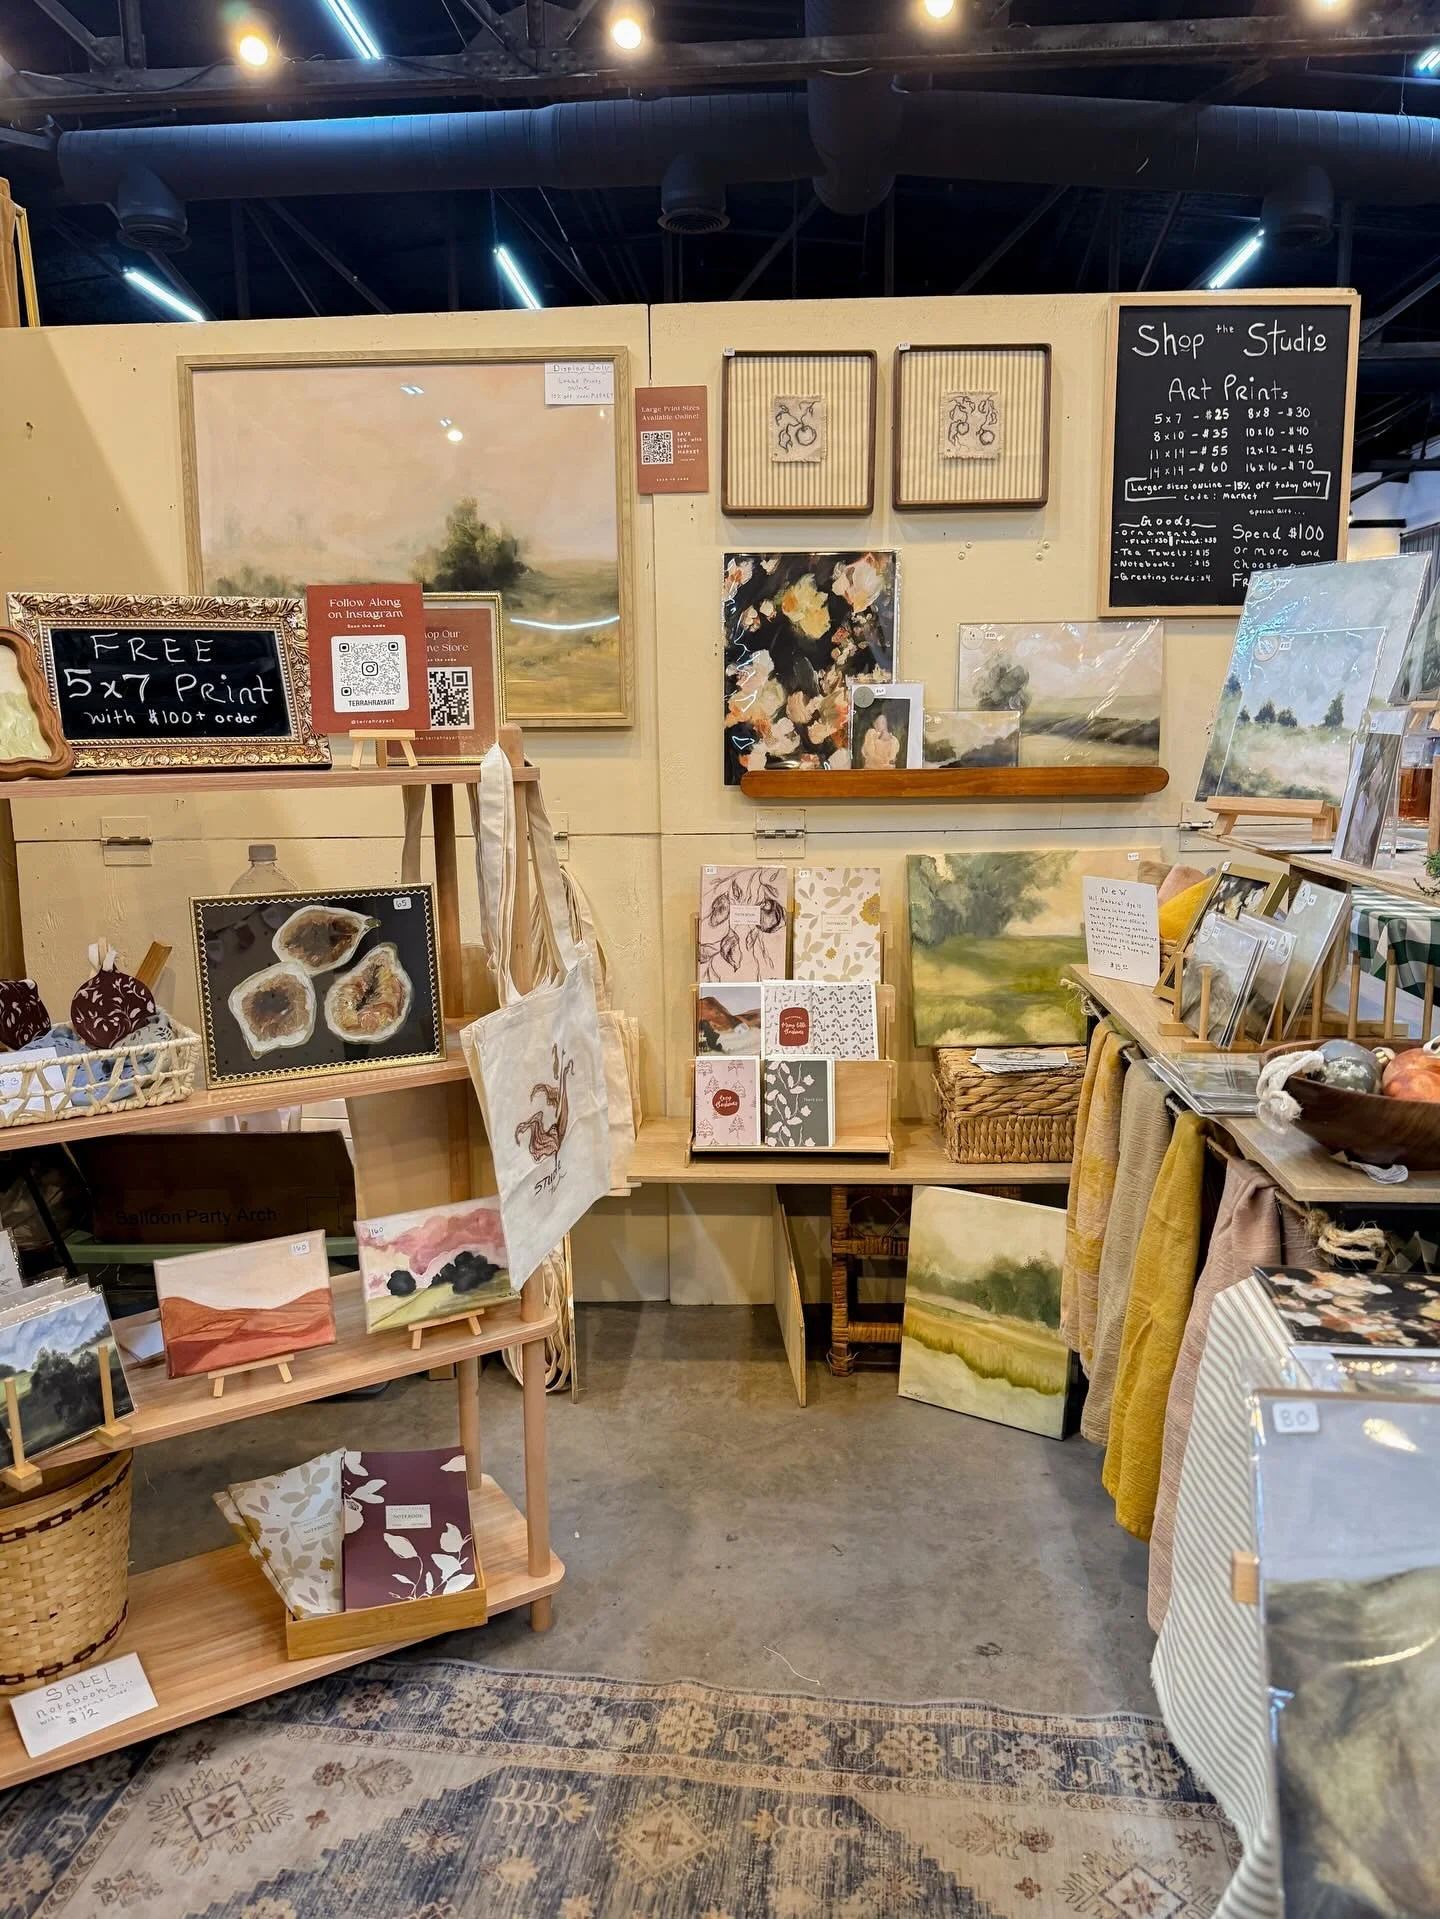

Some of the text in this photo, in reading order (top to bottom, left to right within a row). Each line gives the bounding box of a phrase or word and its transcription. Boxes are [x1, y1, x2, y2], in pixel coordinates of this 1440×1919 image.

[1132, 320, 1327, 359] Shop the Studio
[1168, 374, 1288, 402] Art Prints
[1131, 483, 1162, 495] Larger
[1233, 481, 1250, 491] 15%
[1256, 481, 1270, 490] off
[1275, 481, 1298, 493] today
[1141, 516, 1190, 526] Goods
[1232, 523, 1324, 542] Spend $100
[1254, 547, 1288, 556] more
[1120, 573, 1166, 582] Greeting
[329, 598, 401, 608] Follow Along
[328, 609, 404, 620] on Instagram
[90, 632, 214, 663] FREE
[64, 669, 150, 704] 5x7
[84, 709, 258, 726] with $100+ order
[115, 1207, 278, 1225] Balloon Party Arch
[46, 1668, 112, 1702] SALE!
[69, 1708, 99, 1724] $12
